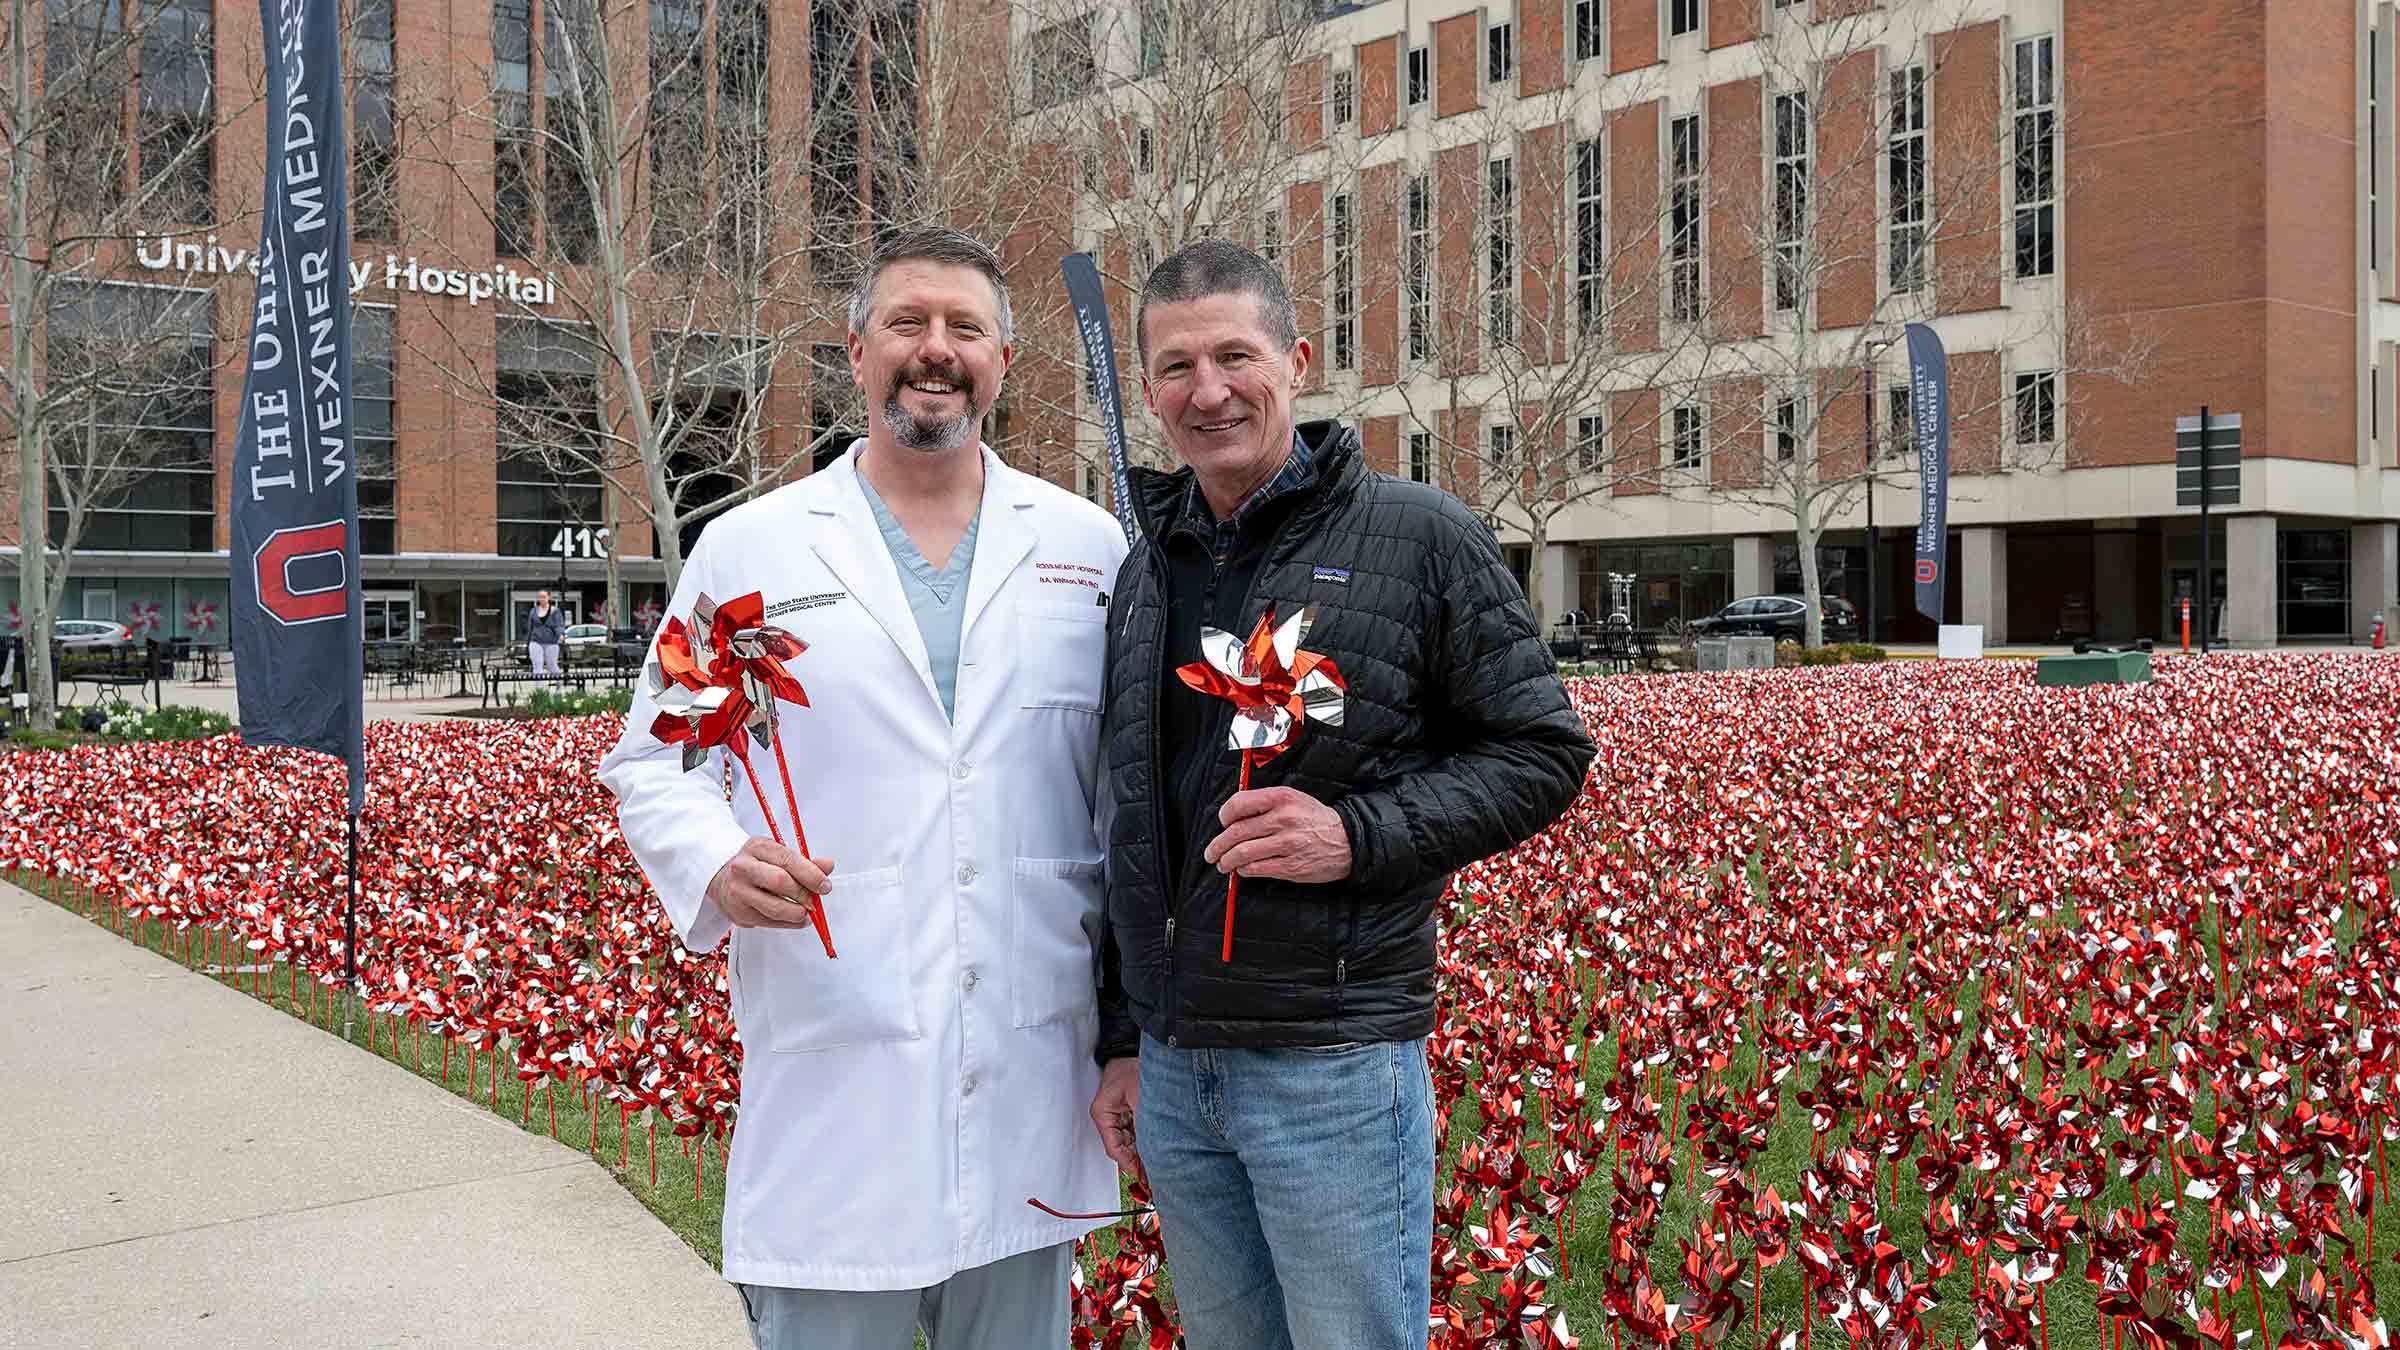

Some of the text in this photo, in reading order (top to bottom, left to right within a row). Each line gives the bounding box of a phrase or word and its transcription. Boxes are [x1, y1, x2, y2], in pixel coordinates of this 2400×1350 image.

[386, 255, 555, 305] Hospital
[300, 247, 346, 486] WEXNER
[1093, 320, 1110, 389] CENTER
[251, 388, 297, 502] THE
[1106, 391, 1125, 471] MEDICAL
[1927, 379, 1938, 553] WEXNER MEDICAL CENTER
[788, 604, 814, 613] MEDICAL
[814, 600, 837, 608] CENTER
[791, 596, 809, 604] STATE
[810, 592, 846, 601] UNIVERSITY
